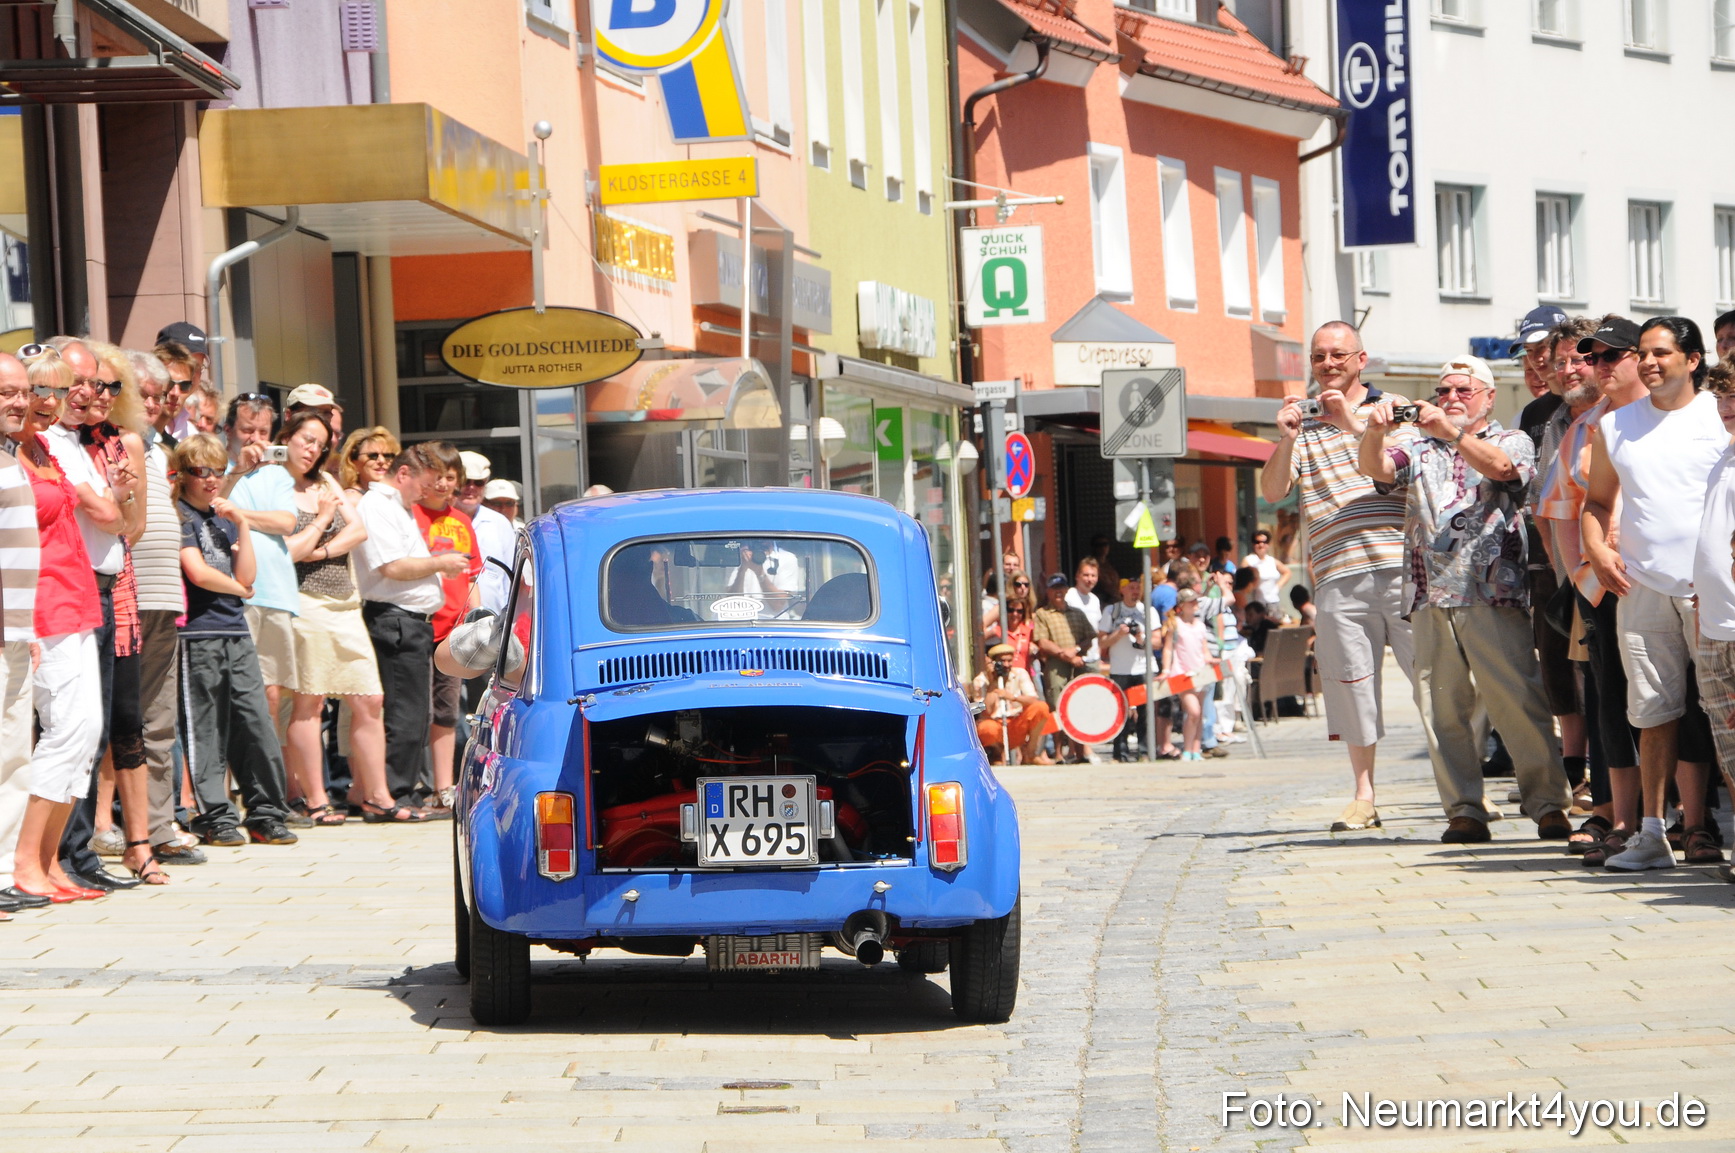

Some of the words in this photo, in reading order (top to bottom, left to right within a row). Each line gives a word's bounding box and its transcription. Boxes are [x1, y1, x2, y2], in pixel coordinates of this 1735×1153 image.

[1388, 98, 1409, 217] TOM
[608, 169, 731, 192] KLOSTERGASSE
[738, 169, 746, 183] 4
[981, 233, 1024, 245] QUICK
[980, 245, 1027, 257] SCHUH
[981, 257, 1029, 318] Q
[452, 344, 484, 358] DIE
[488, 338, 636, 357] GOLDSCHMIEDE
[1078, 344, 1154, 368] Creppresso
[502, 364, 535, 375] JUTTA
[538, 363, 583, 373] ROTHER
[1123, 433, 1163, 448] ZONE
[719, 601, 755, 611] MINOX
[711, 803, 719, 814] D
[728, 784, 774, 818] RH
[710, 823, 731, 857] X
[741, 822, 806, 856] 695
[736, 952, 800, 965] ABARTH
